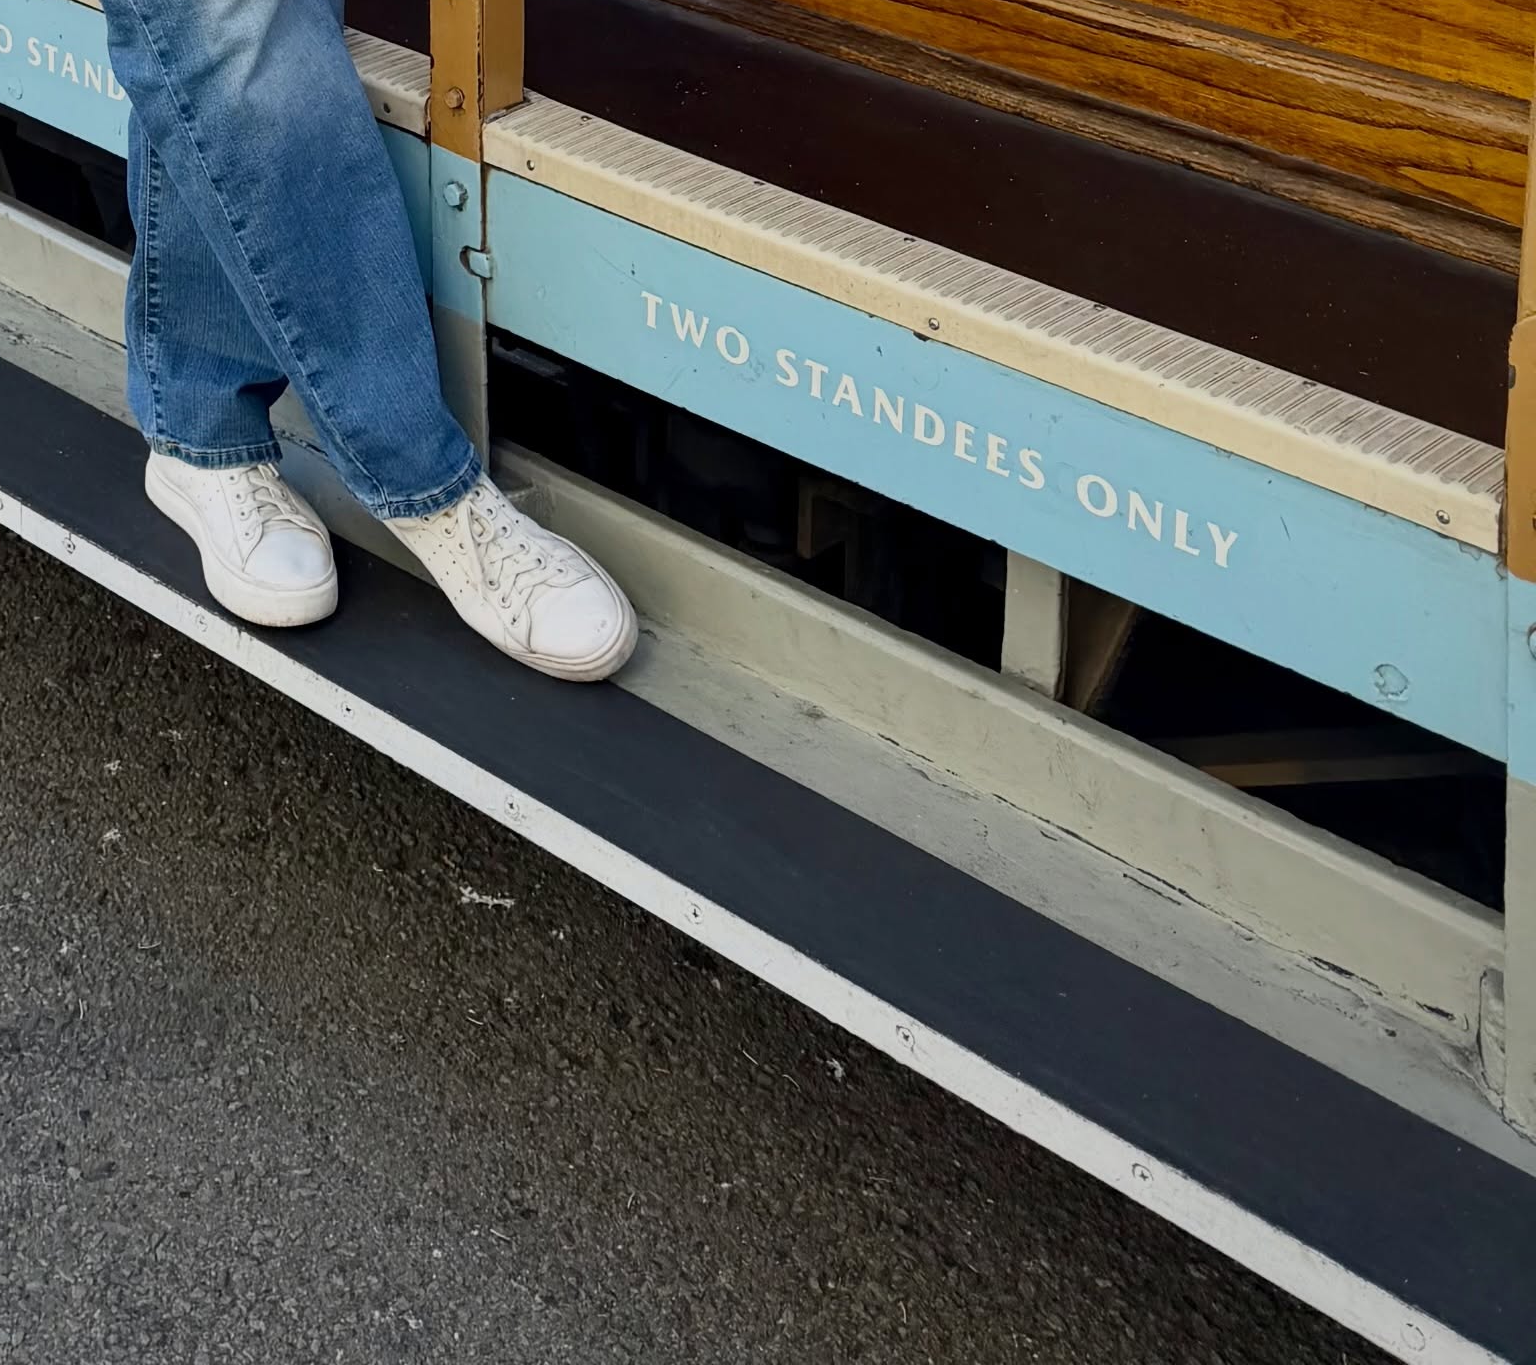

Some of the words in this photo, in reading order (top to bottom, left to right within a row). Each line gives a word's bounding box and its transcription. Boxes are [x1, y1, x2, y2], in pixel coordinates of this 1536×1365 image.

[639, 290, 751, 366] TWO
[775, 347, 1047, 491] STANDEES
[1075, 472, 1240, 569] ONLY
